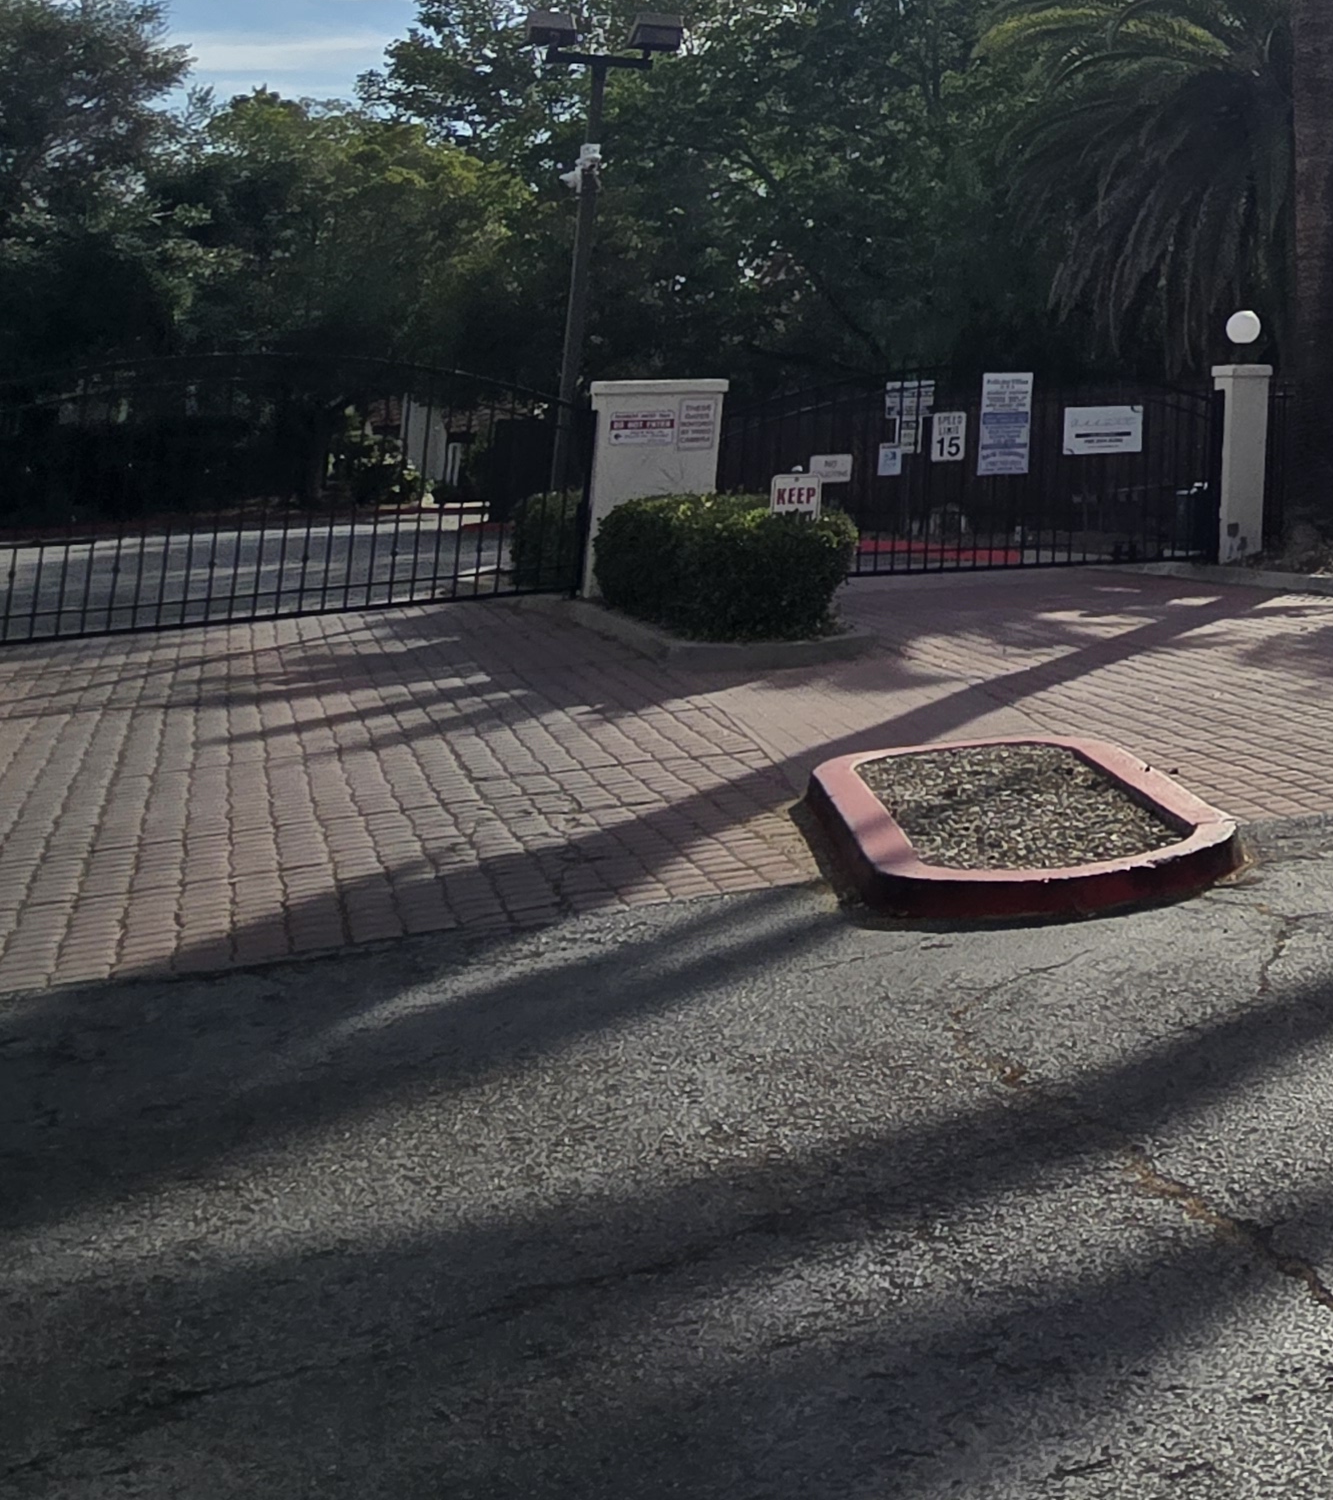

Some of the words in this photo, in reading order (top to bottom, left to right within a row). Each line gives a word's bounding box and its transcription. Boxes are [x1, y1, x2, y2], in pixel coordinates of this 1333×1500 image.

[627, 421, 643, 429] NOT
[646, 420, 671, 429] ENTER
[938, 415, 963, 426] SPEED
[938, 426, 959, 436] LIMIT
[936, 436, 961, 457] 15
[776, 487, 816, 506] KEEP
